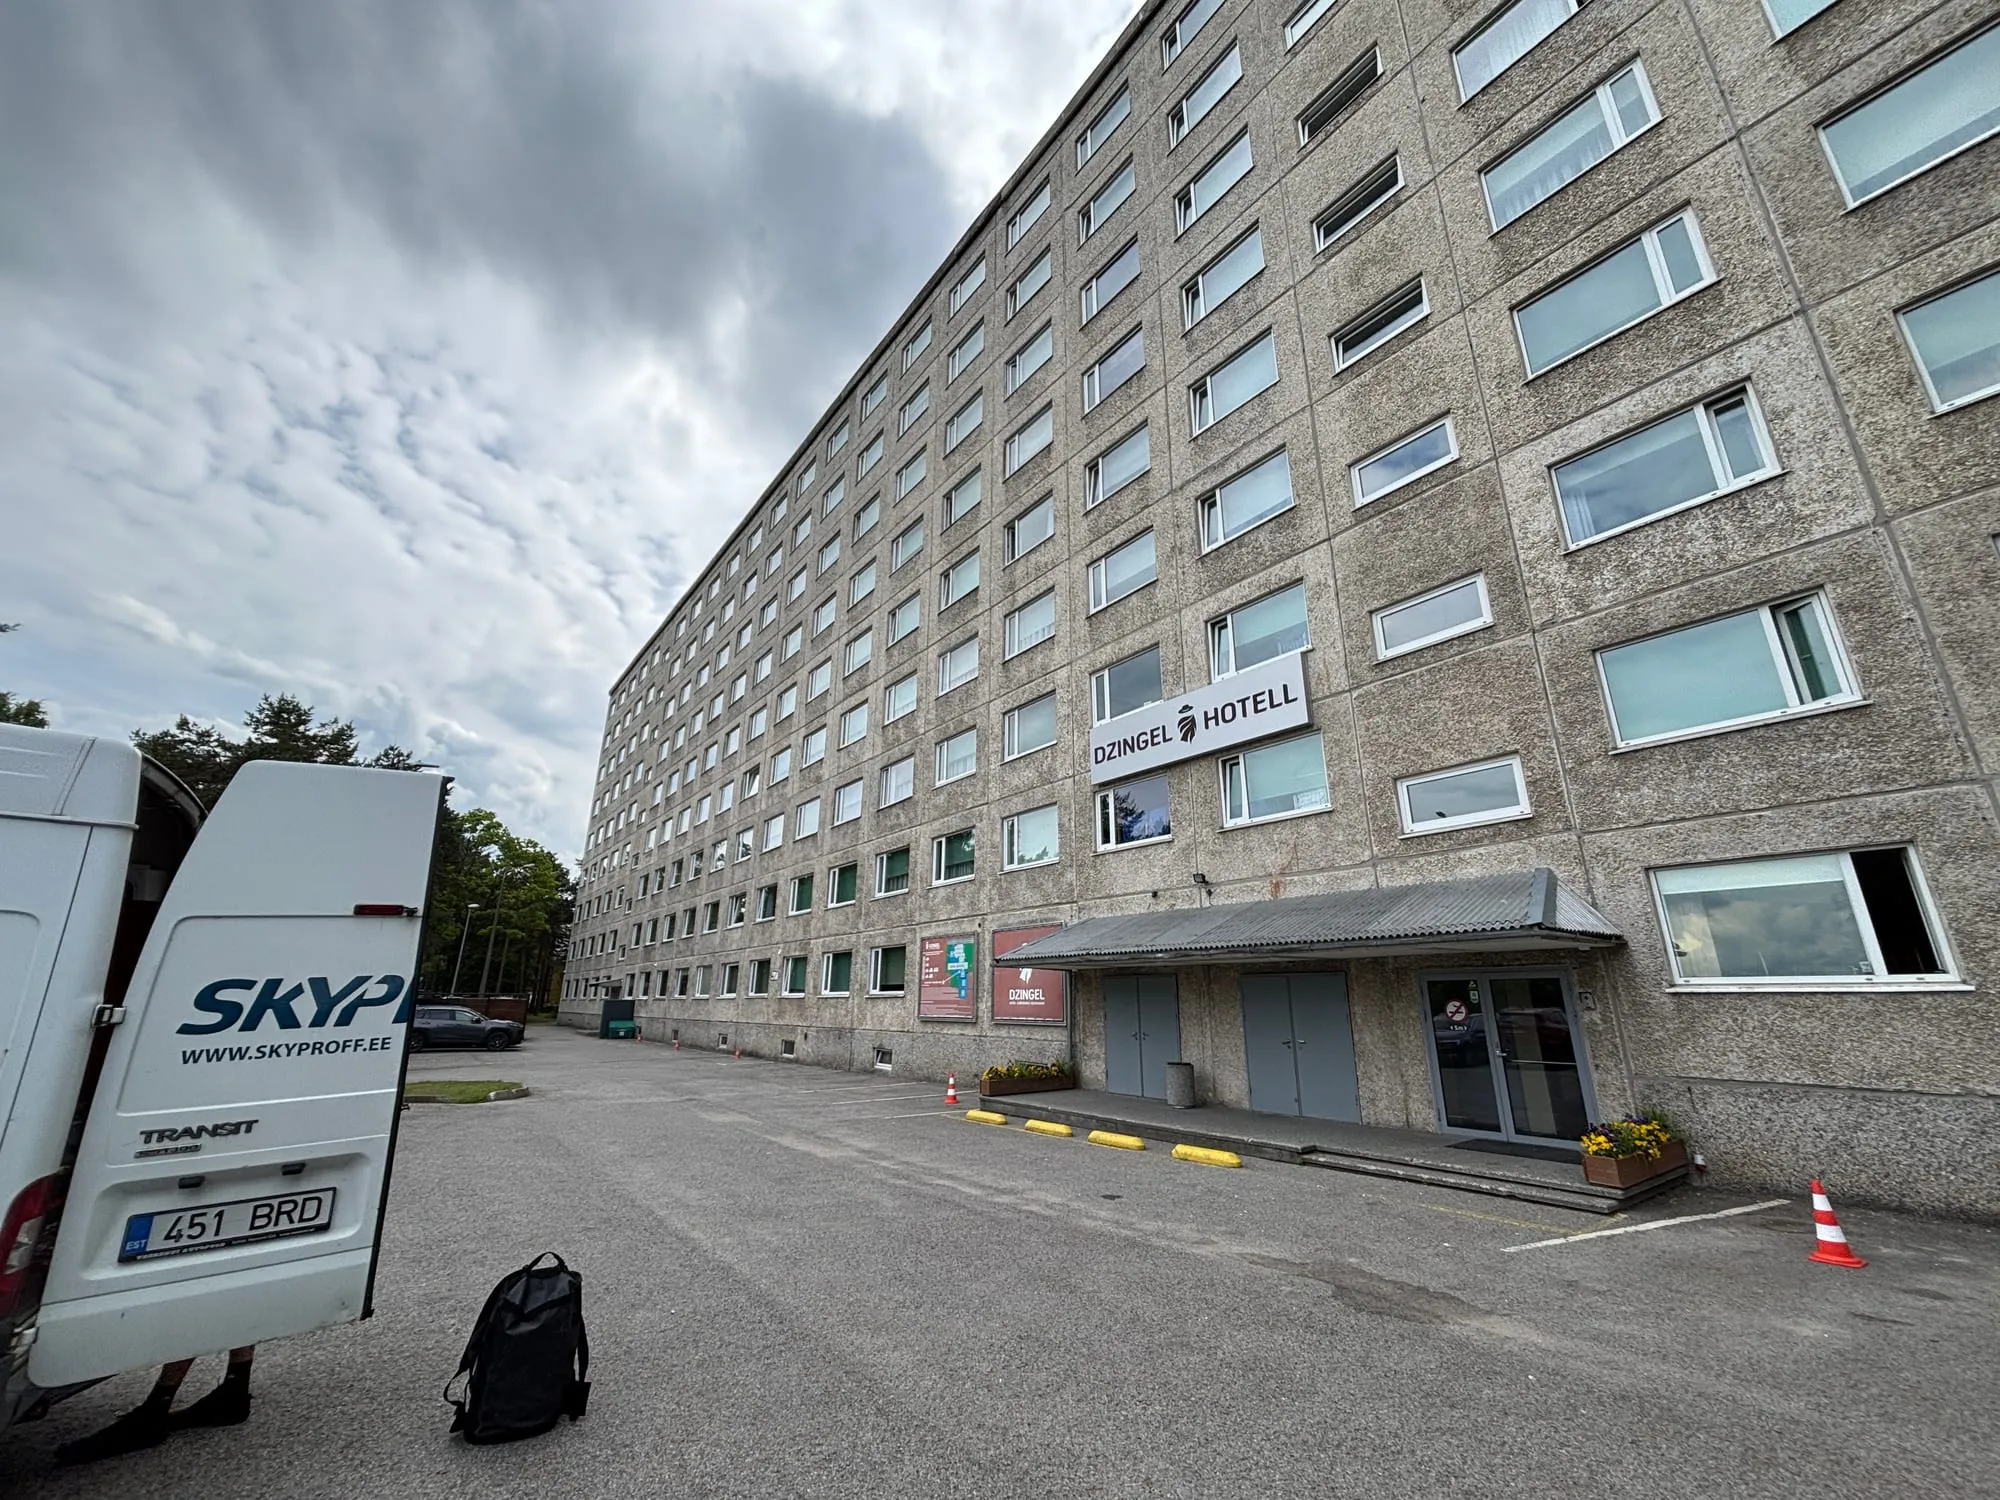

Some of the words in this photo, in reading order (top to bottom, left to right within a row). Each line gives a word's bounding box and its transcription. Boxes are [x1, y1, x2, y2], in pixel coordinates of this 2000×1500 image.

[1094, 725, 1173, 765] DZINGEL
[1203, 684, 1298, 730] HOTELL
[1009, 989, 1045, 1001] DZINGEL
[182, 1037, 392, 1065] WWW.SKYPROFF.EE
[139, 1119, 259, 1144] TRANSIT
[163, 1210, 225, 1243] 451
[249, 1196, 322, 1232] BRD
[125, 1239, 147, 1251] EST
